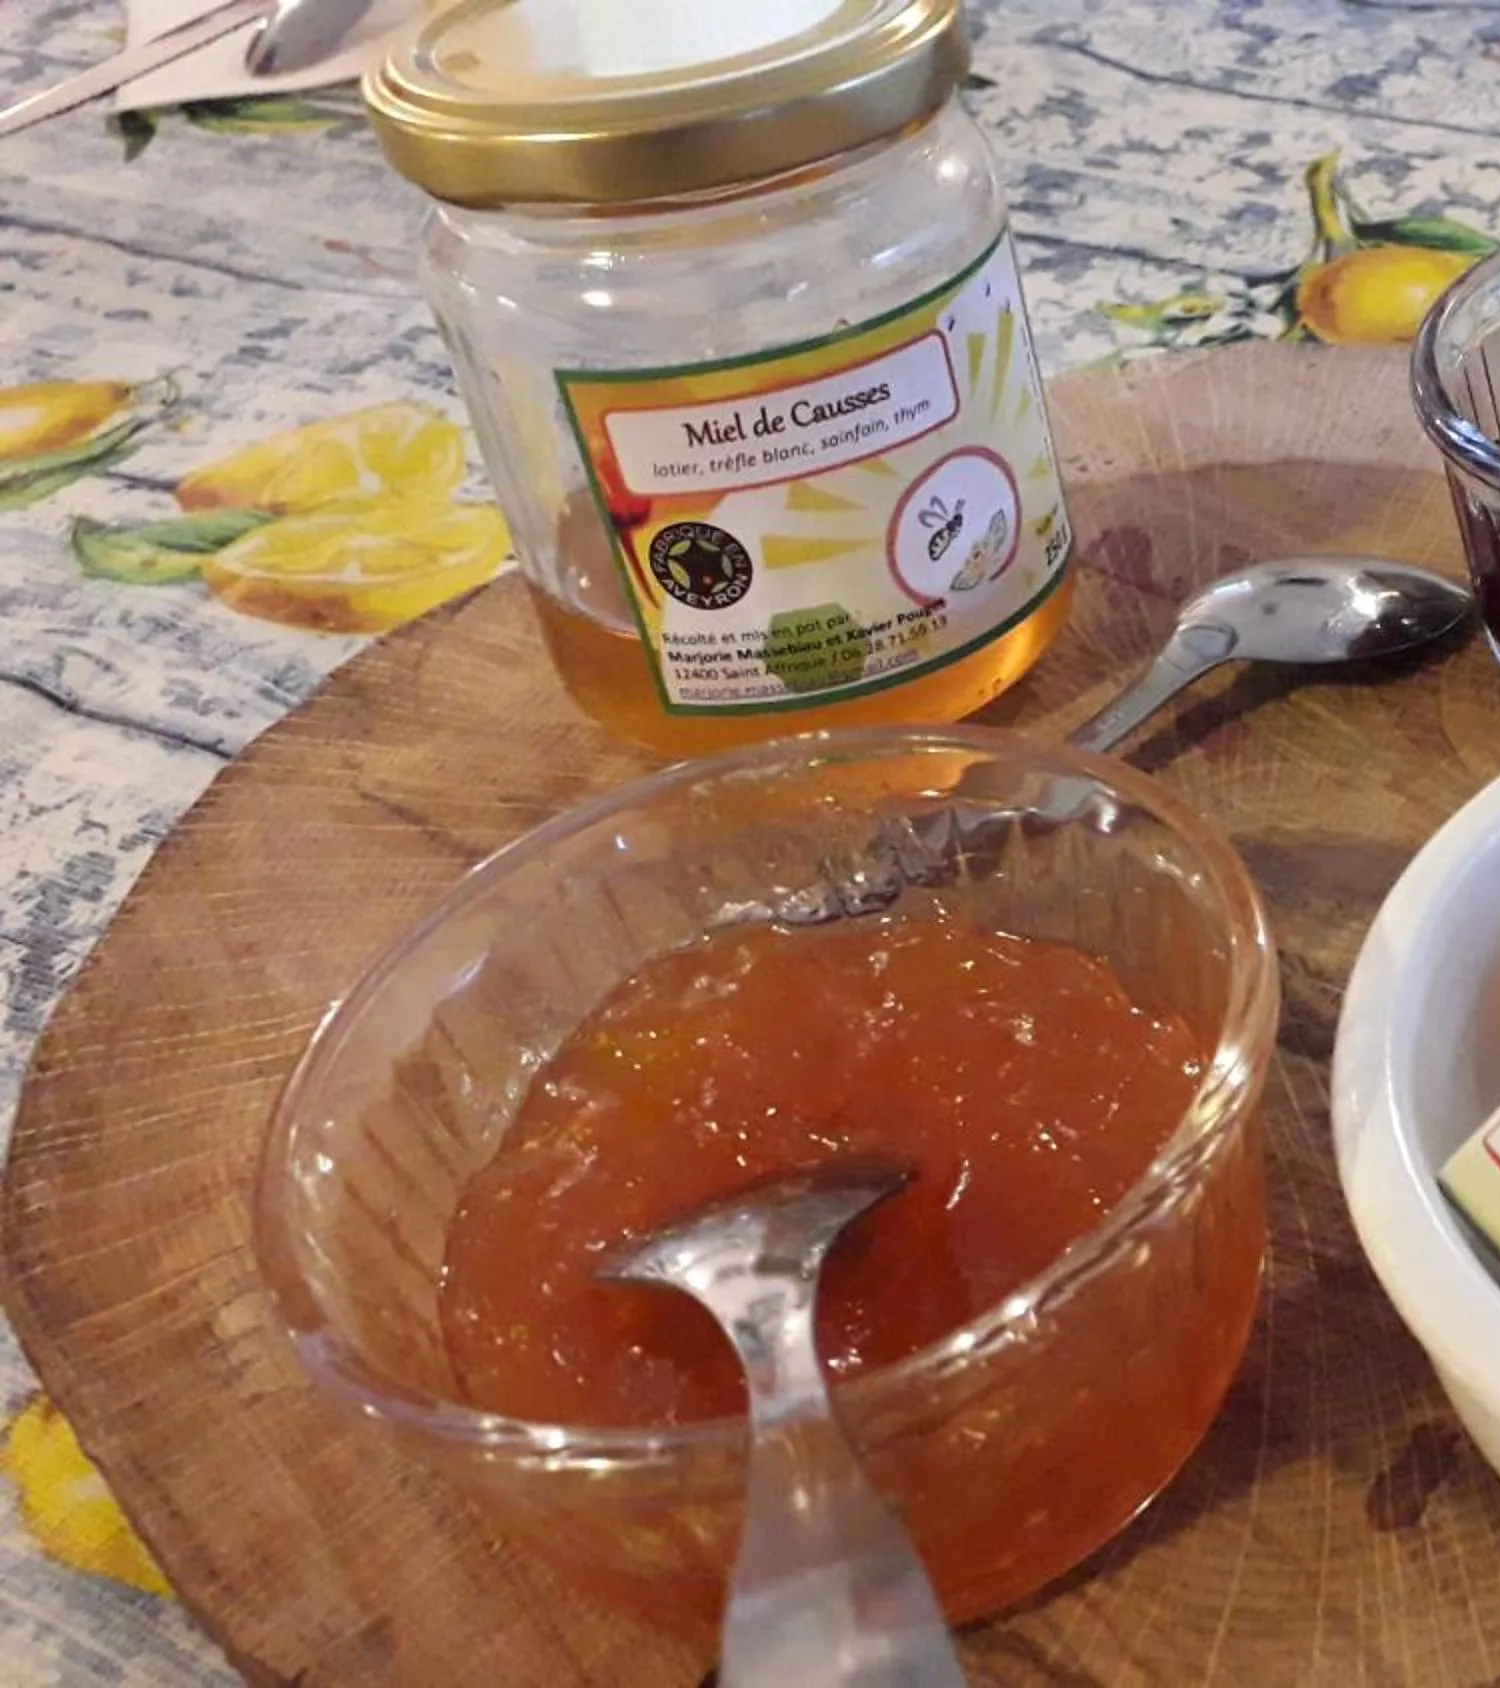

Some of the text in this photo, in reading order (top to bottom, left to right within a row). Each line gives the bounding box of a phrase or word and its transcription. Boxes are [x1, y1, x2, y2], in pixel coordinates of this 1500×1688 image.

[682, 382, 892, 448] Miel de Causses
[653, 462, 705, 479] lotier,
[710, 451, 757, 476] trèfle
[763, 443, 816, 466] blanc,
[894, 398, 931, 425] thym
[660, 573, 750, 607] AVEYRON
[667, 651, 733, 665] Marjorie
[824, 633, 843, 646] et
[845, 619, 893, 643] Xavier
[721, 631, 736, 645] et
[741, 629, 769, 643] mis
[796, 619, 821, 637] pot
[674, 667, 720, 681] 12400
[721, 667, 762, 679] Saint
